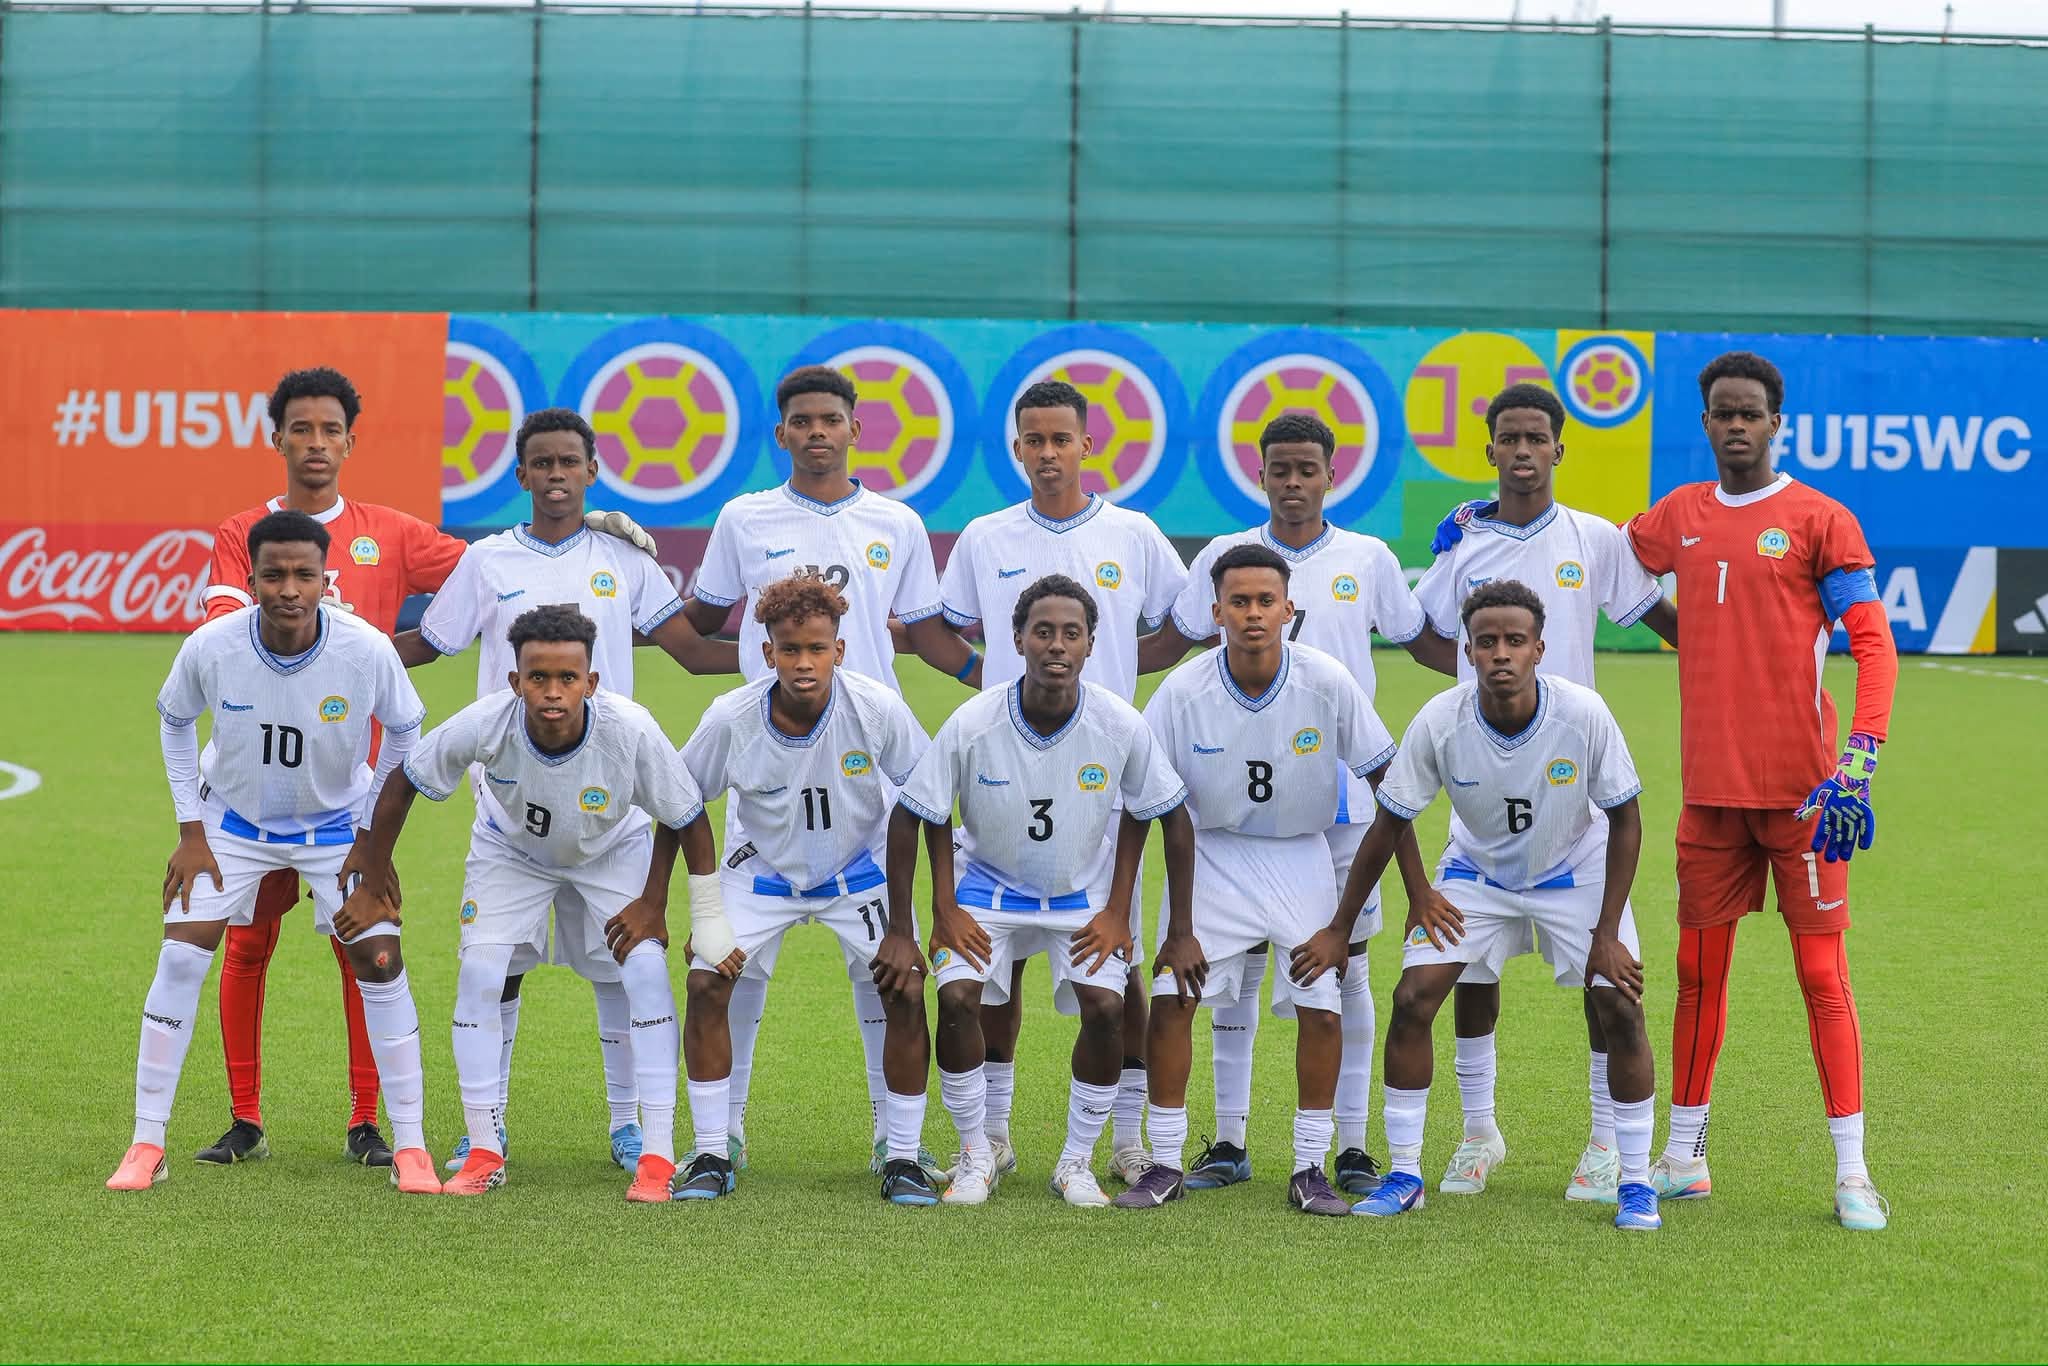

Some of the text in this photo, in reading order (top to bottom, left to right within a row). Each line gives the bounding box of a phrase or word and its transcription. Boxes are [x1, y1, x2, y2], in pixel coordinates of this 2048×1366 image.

[53, 390, 275, 449] #U15W
[1716, 560, 1728, 604] 1
[259, 723, 304, 769] 10
[1245, 760, 1273, 803] 8
[525, 801, 552, 838] 9
[800, 787, 832, 831] 11
[1028, 798, 1054, 842] 3
[1503, 797, 1533, 834] 6
[1801, 851, 1820, 897] 1
[857, 898, 889, 941] 11
